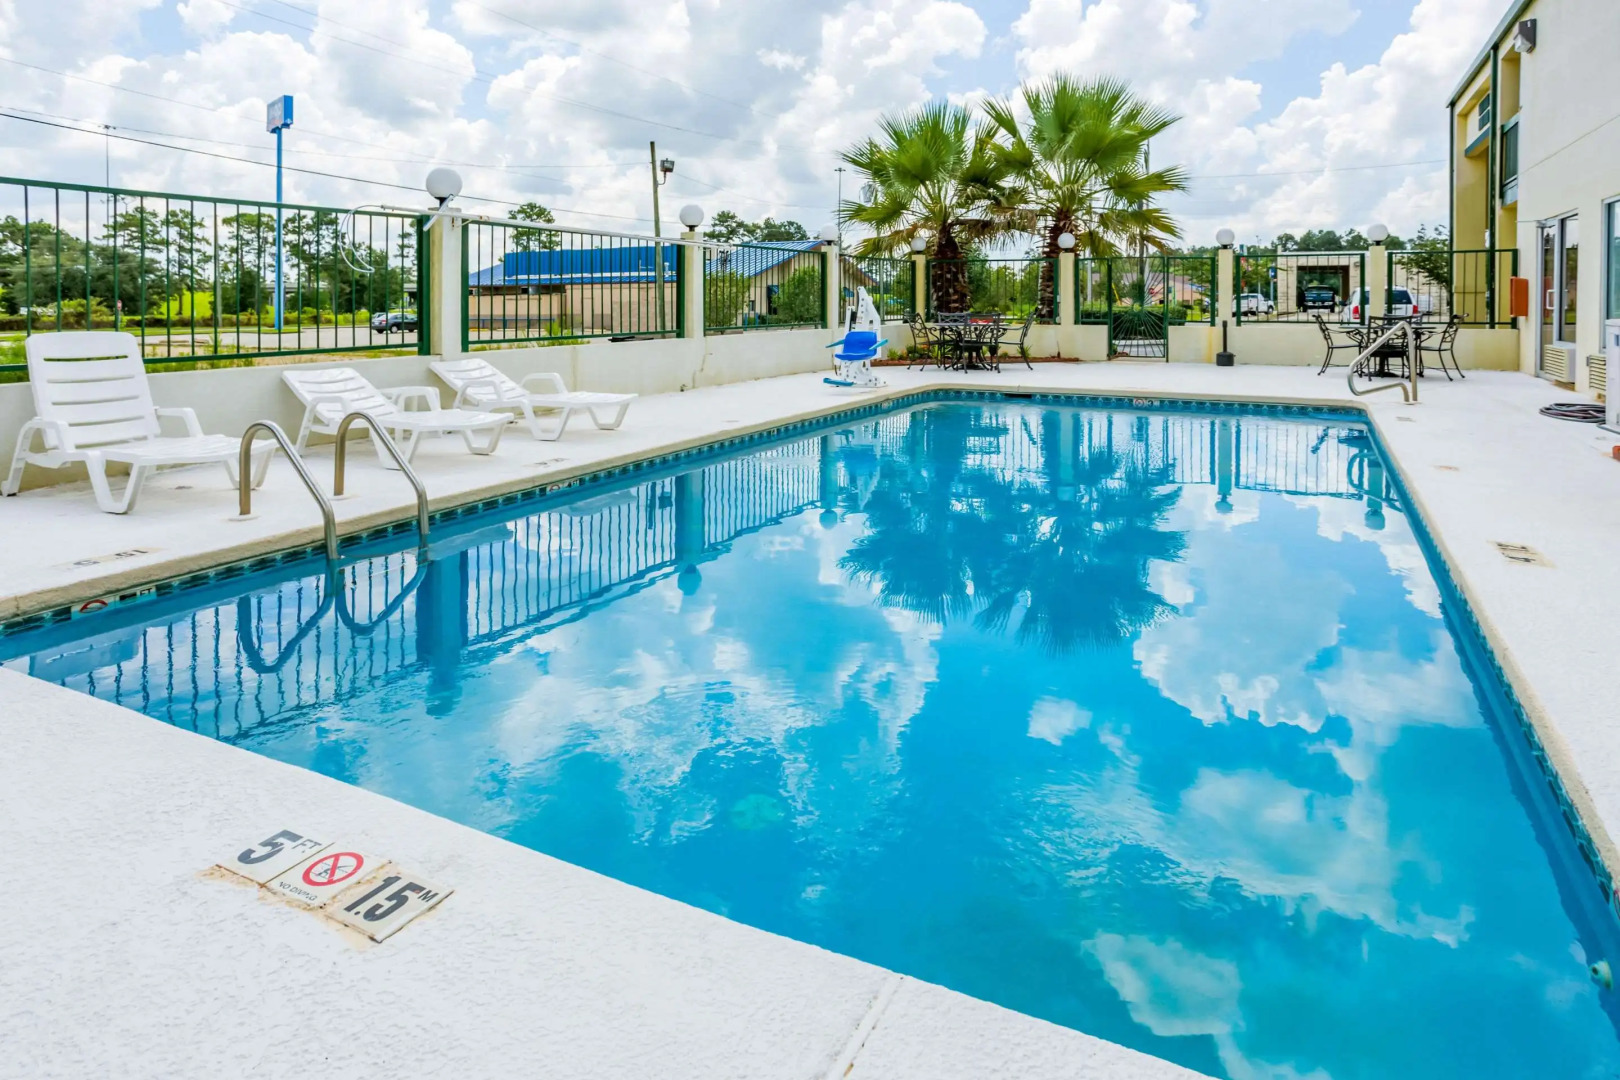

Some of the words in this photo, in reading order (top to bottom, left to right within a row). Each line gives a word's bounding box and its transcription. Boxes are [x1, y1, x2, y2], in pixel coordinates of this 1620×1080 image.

[237, 829, 304, 865] 5
[291, 838, 322, 853] FT
[279, 881, 291, 890] NO
[289, 886, 318, 901] DIVING
[343, 875, 427, 922] 1.5
[417, 889, 440, 903] M
